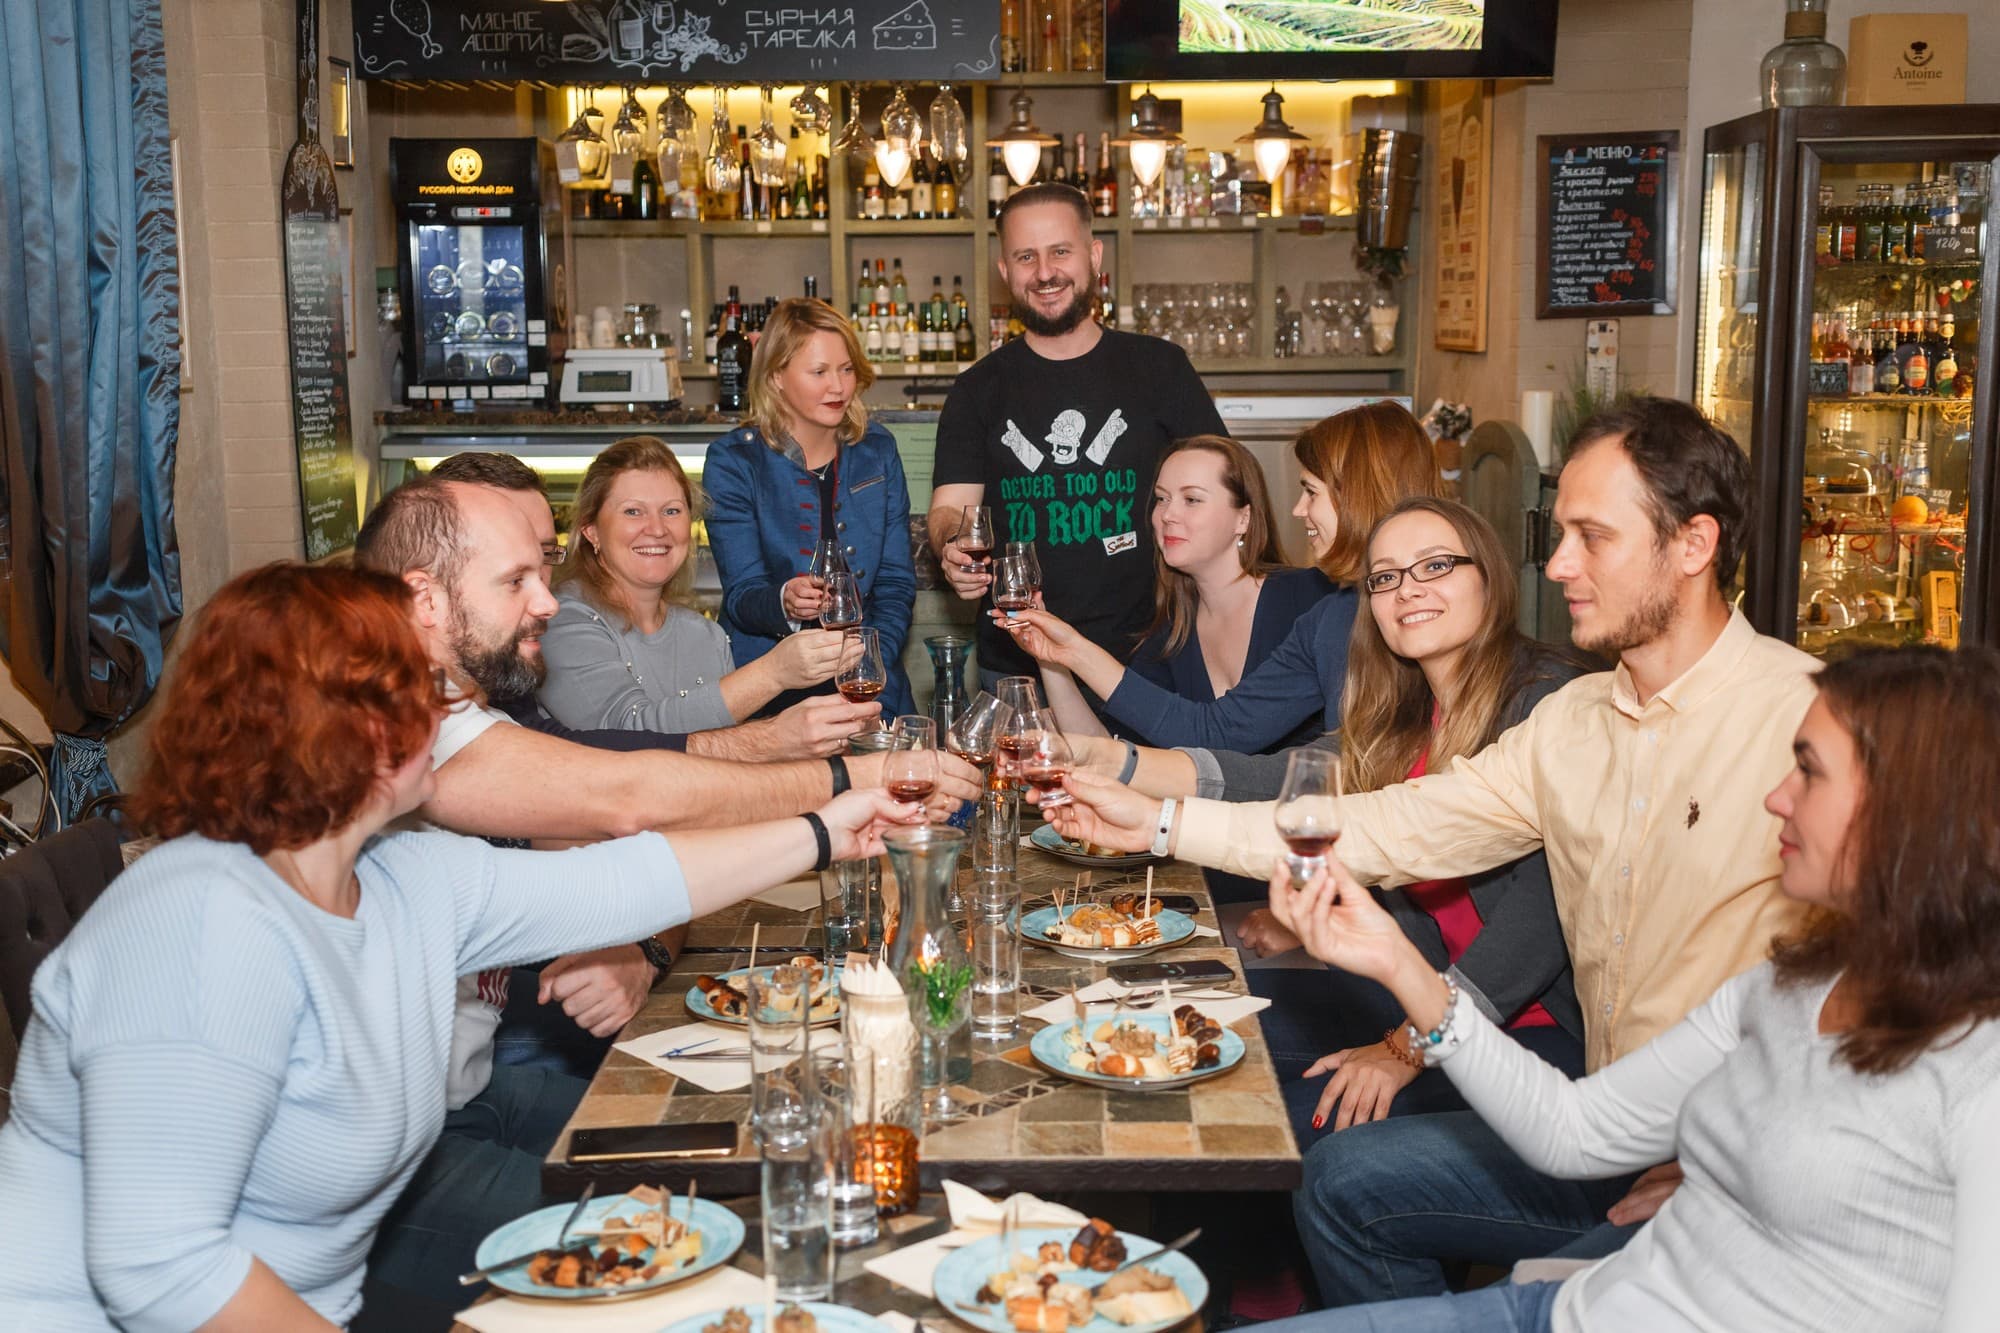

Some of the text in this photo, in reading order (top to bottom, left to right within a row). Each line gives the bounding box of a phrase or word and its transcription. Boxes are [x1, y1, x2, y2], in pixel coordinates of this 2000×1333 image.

[745, 8, 855, 26] СЫРНАЯ
[461, 32, 545, 52] АССОРТИ
[746, 29, 856, 48] ТАРЕЛКА
[1893, 66, 1943, 80] Antoine
[1586, 145, 1633, 160] МЕНЮ
[419, 185, 456, 195] РУССКИЙ
[495, 186, 514, 195] ДОМ
[1001, 469, 1136, 500] NEVER TOO OLD
[1005, 497, 1135, 546] TO ROCK
